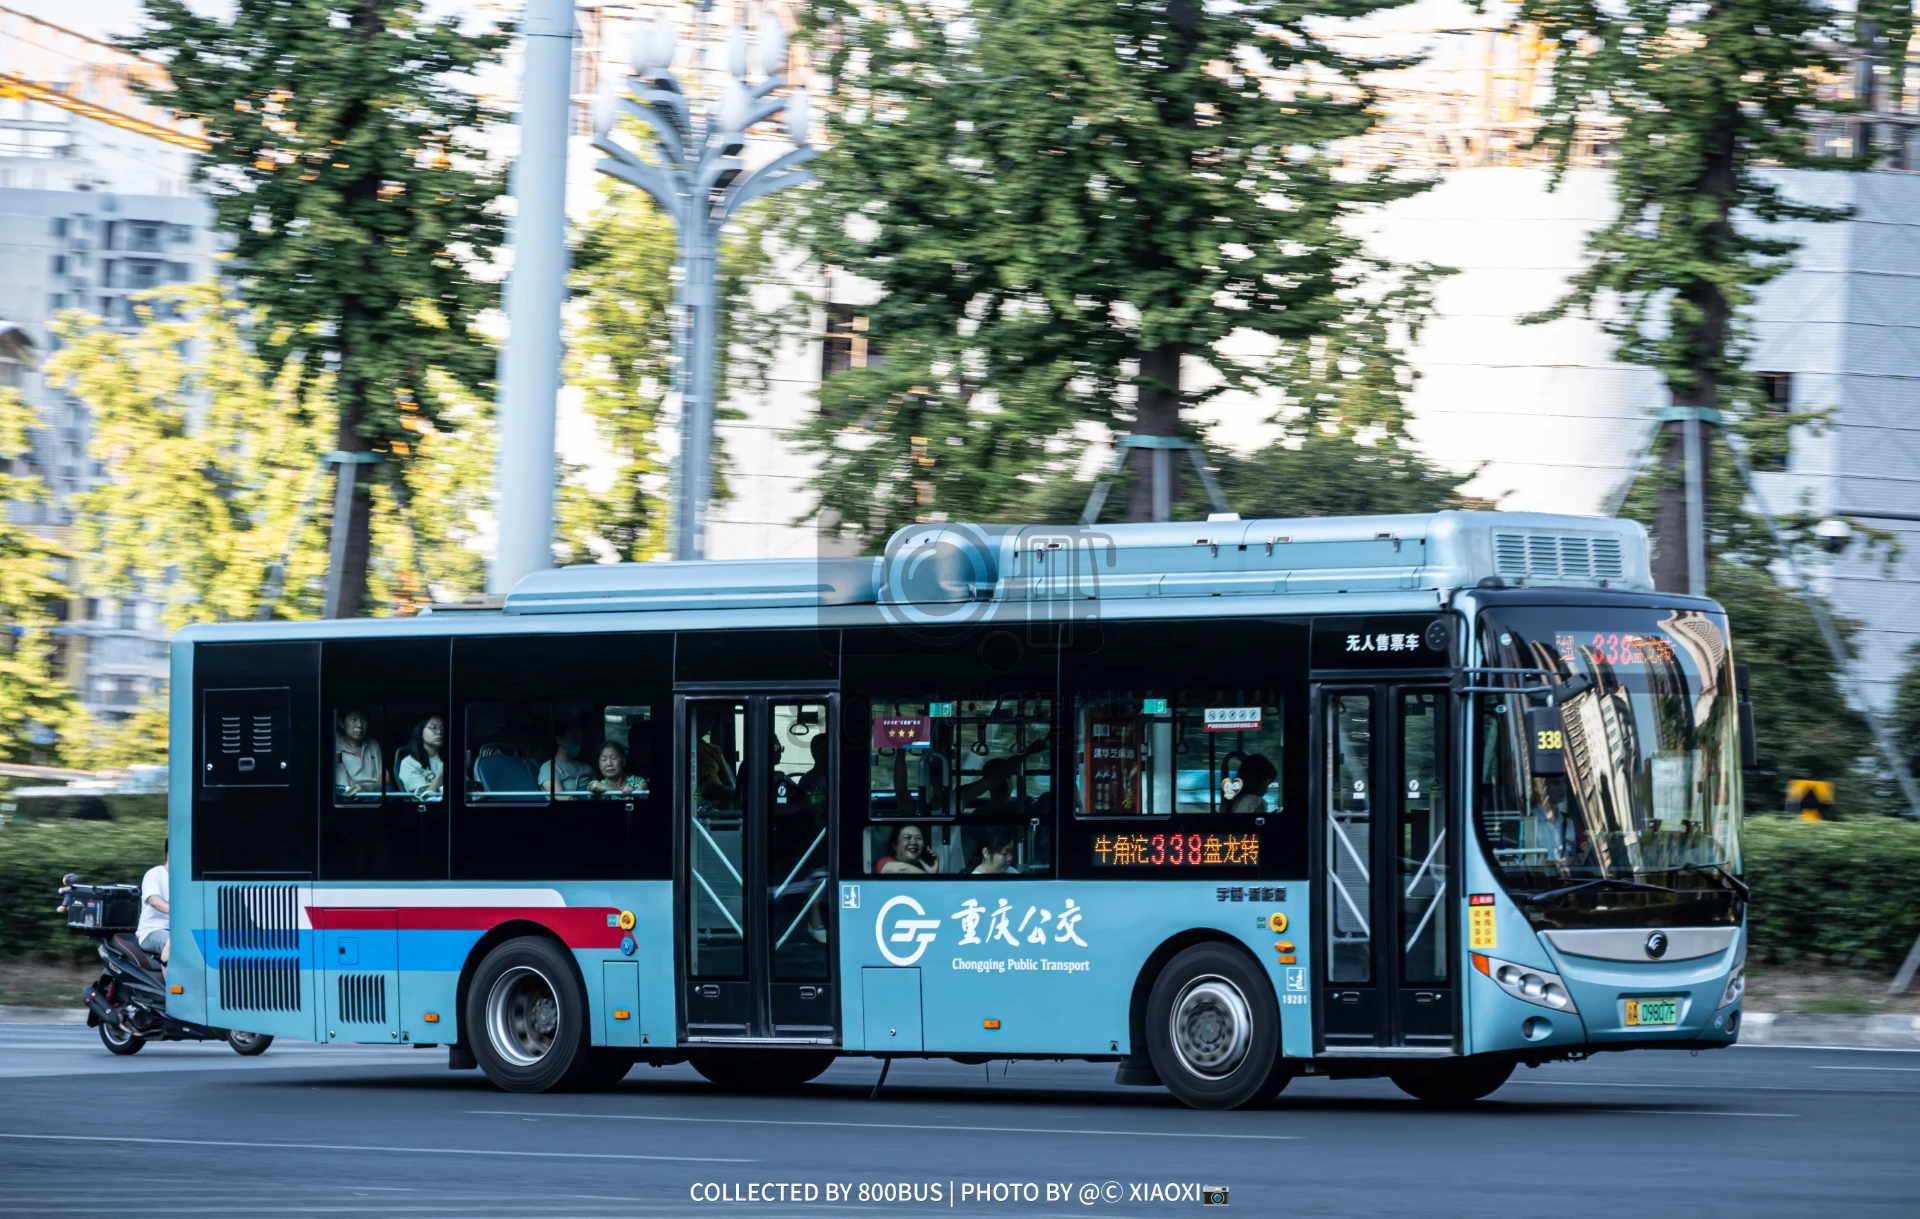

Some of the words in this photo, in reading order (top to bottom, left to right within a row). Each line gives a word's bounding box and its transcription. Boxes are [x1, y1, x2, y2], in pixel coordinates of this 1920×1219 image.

[1346, 633, 1420, 652] 无人售票车
[1538, 730, 1563, 749] 338
[951, 898, 1088, 947] 重庆公交
[952, 958, 1005, 973] Chongqing
[1007, 958, 1038, 971] Public
[1040, 958, 1090, 974] Transport
